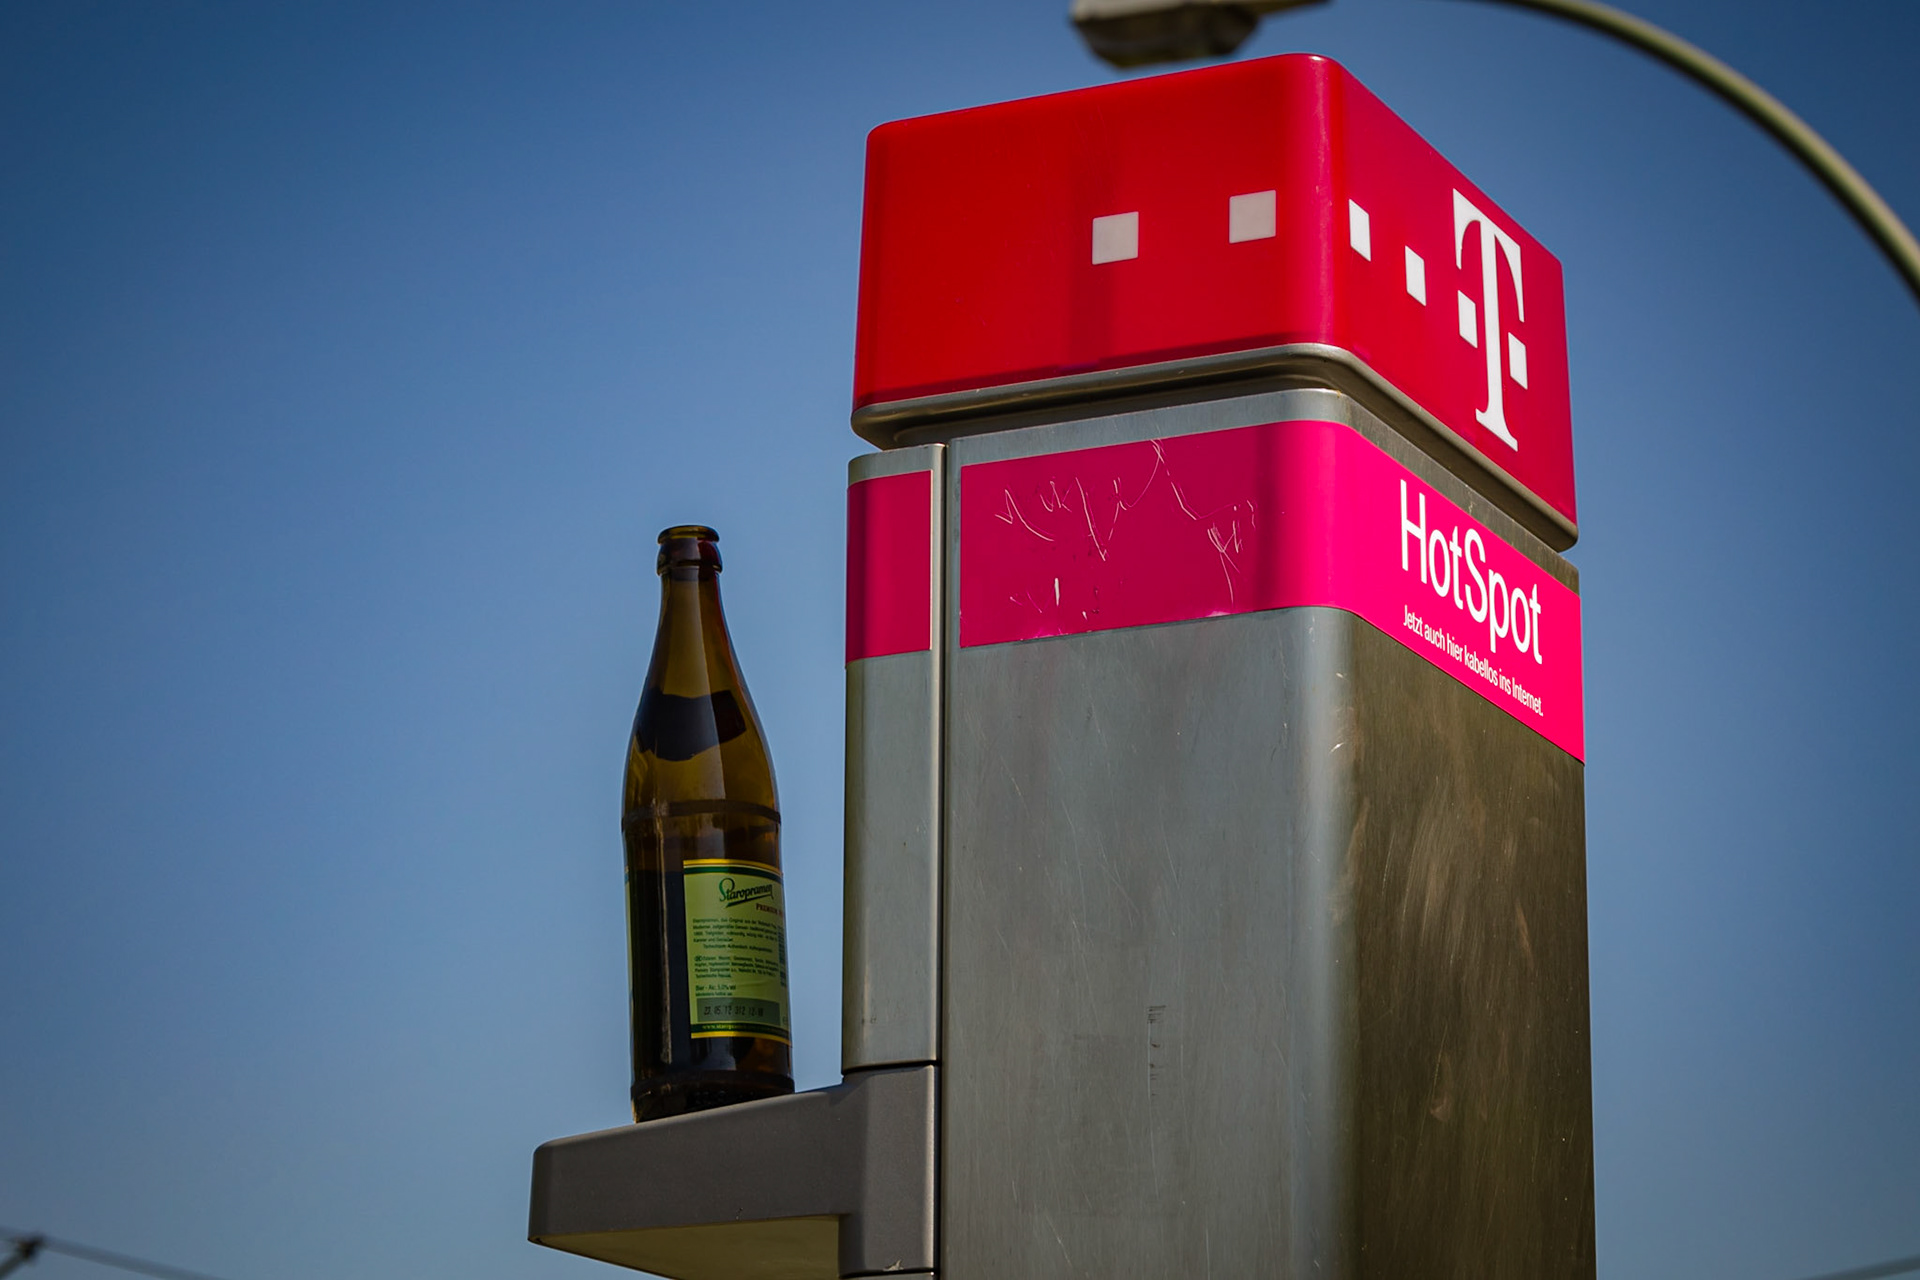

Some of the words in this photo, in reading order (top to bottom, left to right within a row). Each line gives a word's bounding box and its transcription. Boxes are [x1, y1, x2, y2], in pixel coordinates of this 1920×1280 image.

[1453, 188, 1527, 452] T
[1400, 479, 1543, 665] HotSpot
[1403, 604, 1423, 637] Jetzt
[1424, 624, 1446, 651] auch
[1446, 633, 1464, 662] hier
[1464, 645, 1499, 686] kabellos
[1499, 668, 1512, 695] ins
[1512, 677, 1544, 717] Internet.
[719, 877, 774, 902] Staropramen
